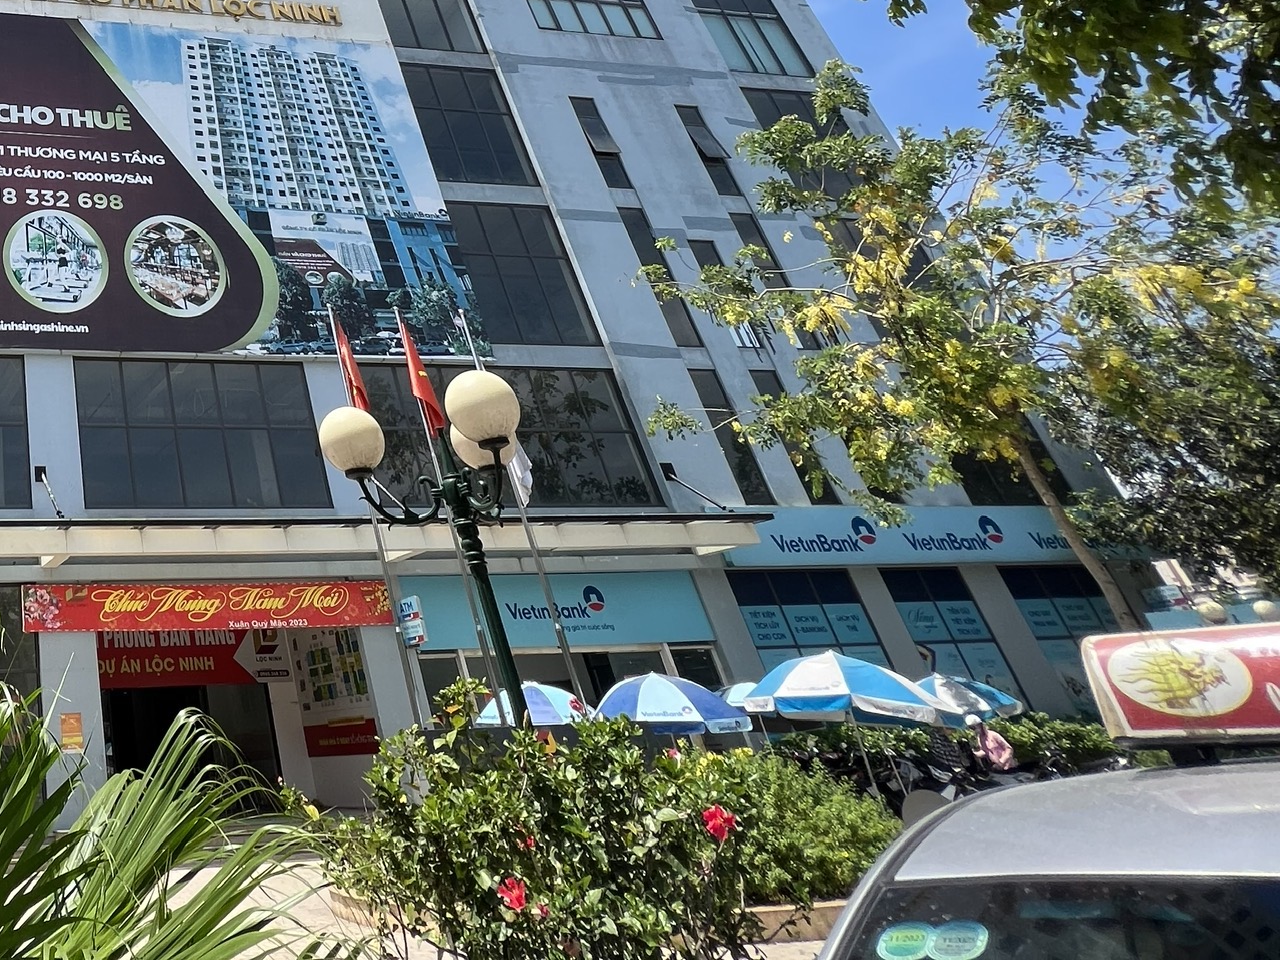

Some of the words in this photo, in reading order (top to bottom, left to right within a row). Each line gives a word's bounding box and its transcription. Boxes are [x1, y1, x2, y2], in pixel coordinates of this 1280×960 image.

[270, 0, 343, 26] NINH
[55, 104, 132, 131] THUÊ
[7, 144, 76, 161] THƯƠNG
[79, 150, 108, 165] MẠI
[110, 152, 120, 163] 5
[122, 149, 166, 166] TẦNG
[13, 165, 42, 179] CẦU
[104, 172, 153, 185] M2/SÀN
[25, 189, 70, 208] 332
[77, 192, 124, 210] 698
[770, 533, 864, 554] VietinBank
[902, 532, 993, 552] VietinBank
[91, 588, 151, 622] Chúc
[399, 601, 414, 614] ATM
[229, 620, 250, 628] Xuân
[288, 618, 308, 627] 2023
[120, 655, 141, 674] ÁN
[145, 654, 175, 676] LỘC
[179, 657, 215, 672] NINH
